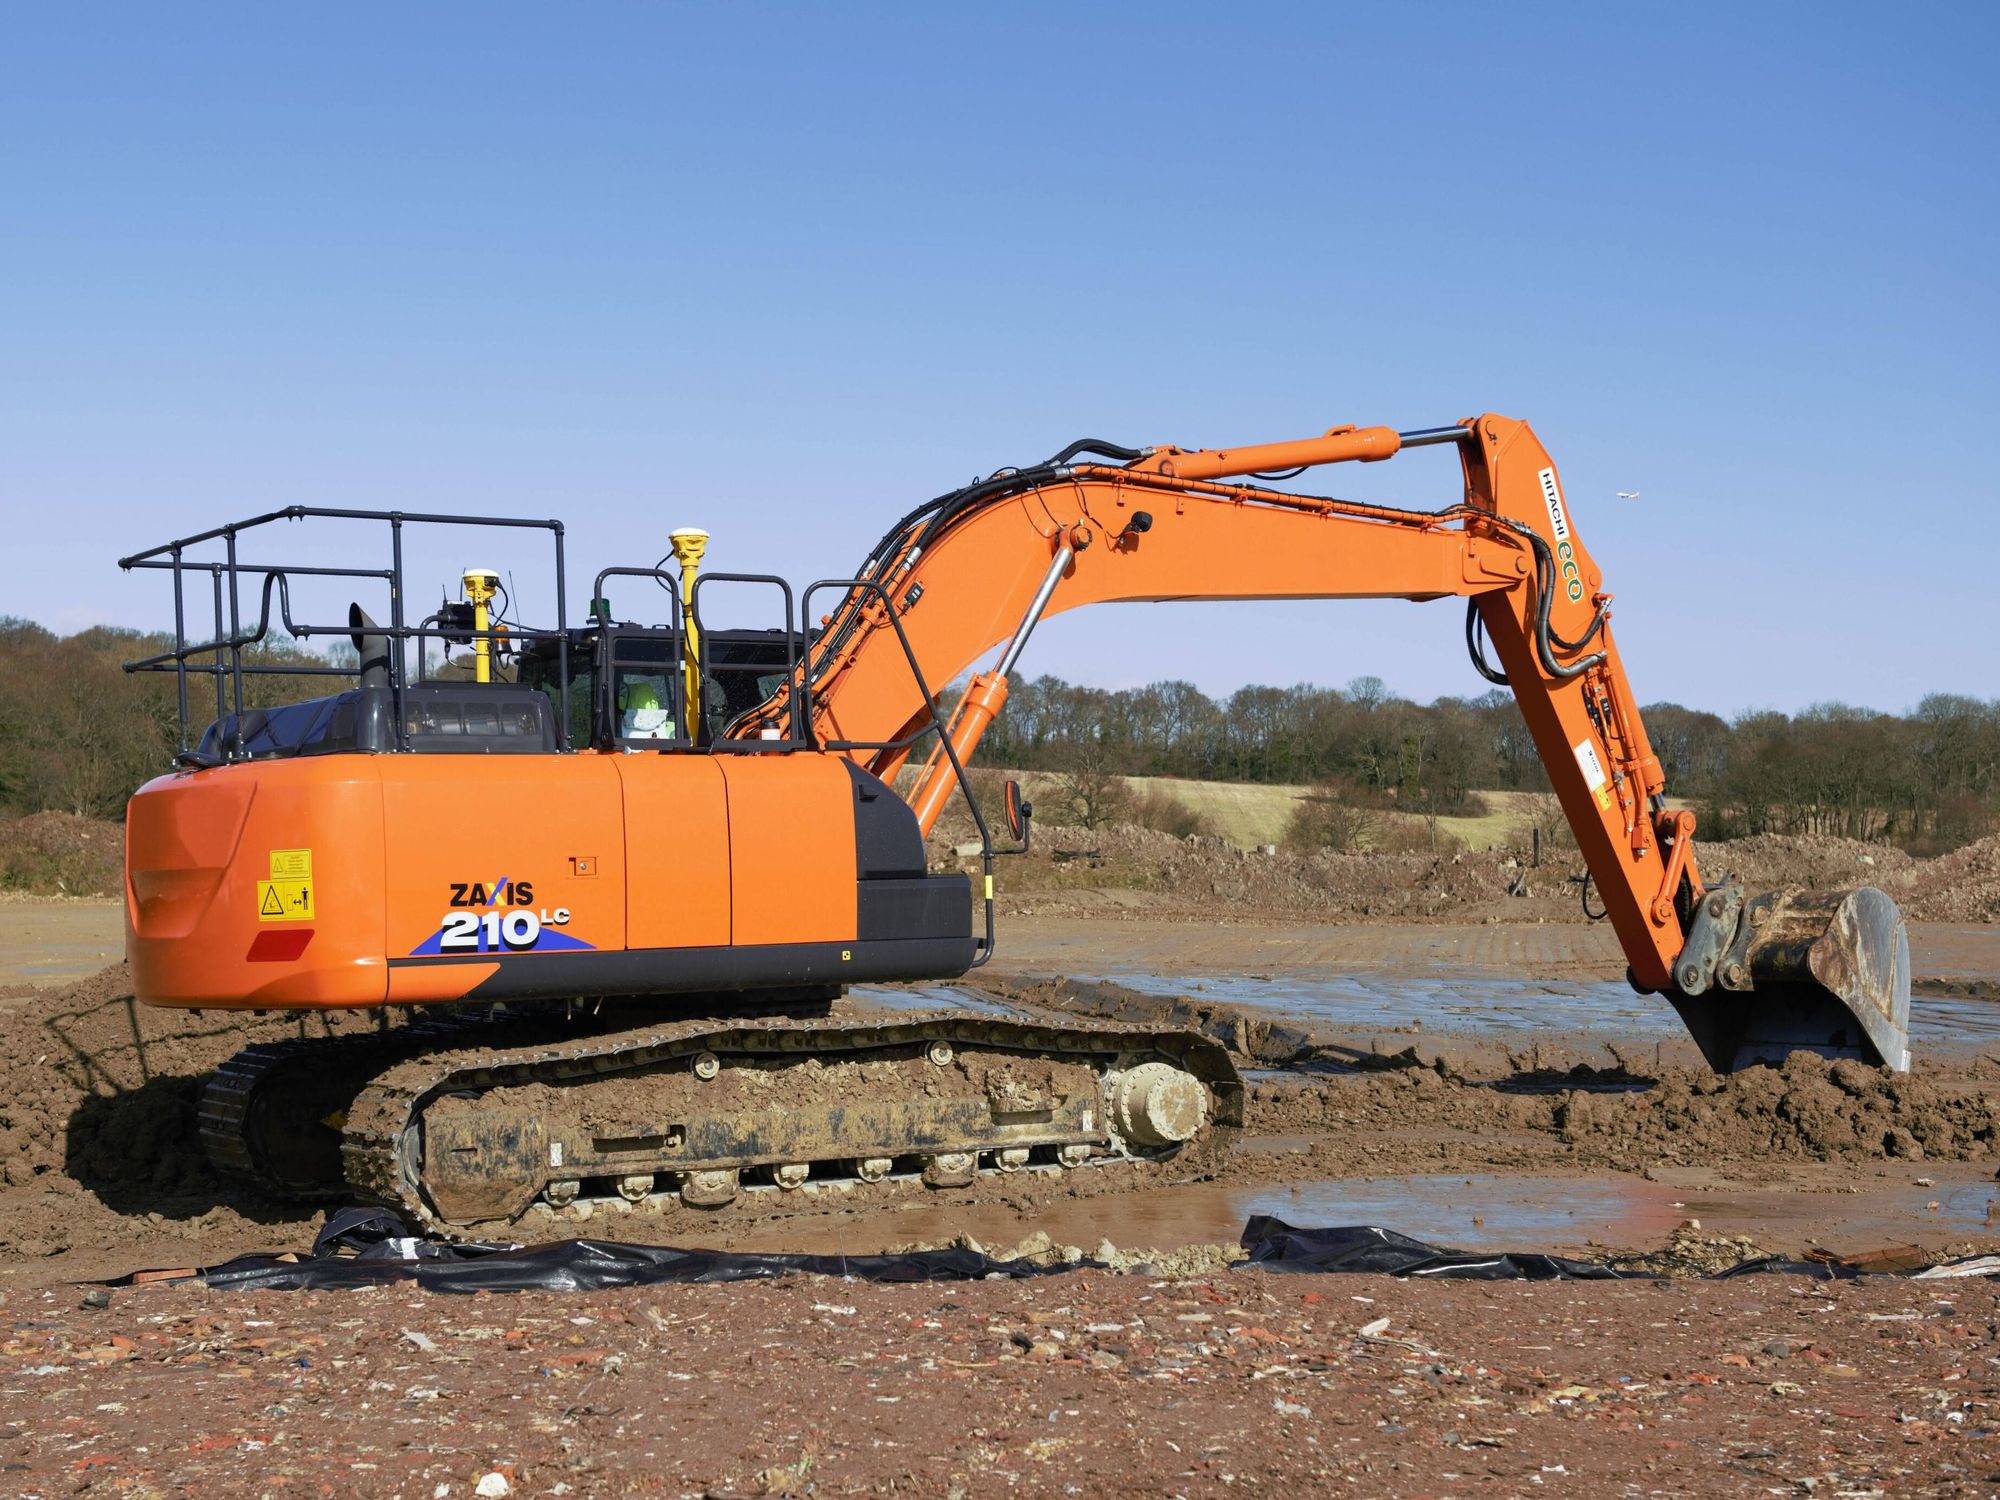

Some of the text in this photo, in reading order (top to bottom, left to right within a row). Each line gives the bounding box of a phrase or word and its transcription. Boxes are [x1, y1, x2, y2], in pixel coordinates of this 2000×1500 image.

[1543, 473, 1583, 602] HITACHI eco
[450, 877, 534, 906] ZAXIS
